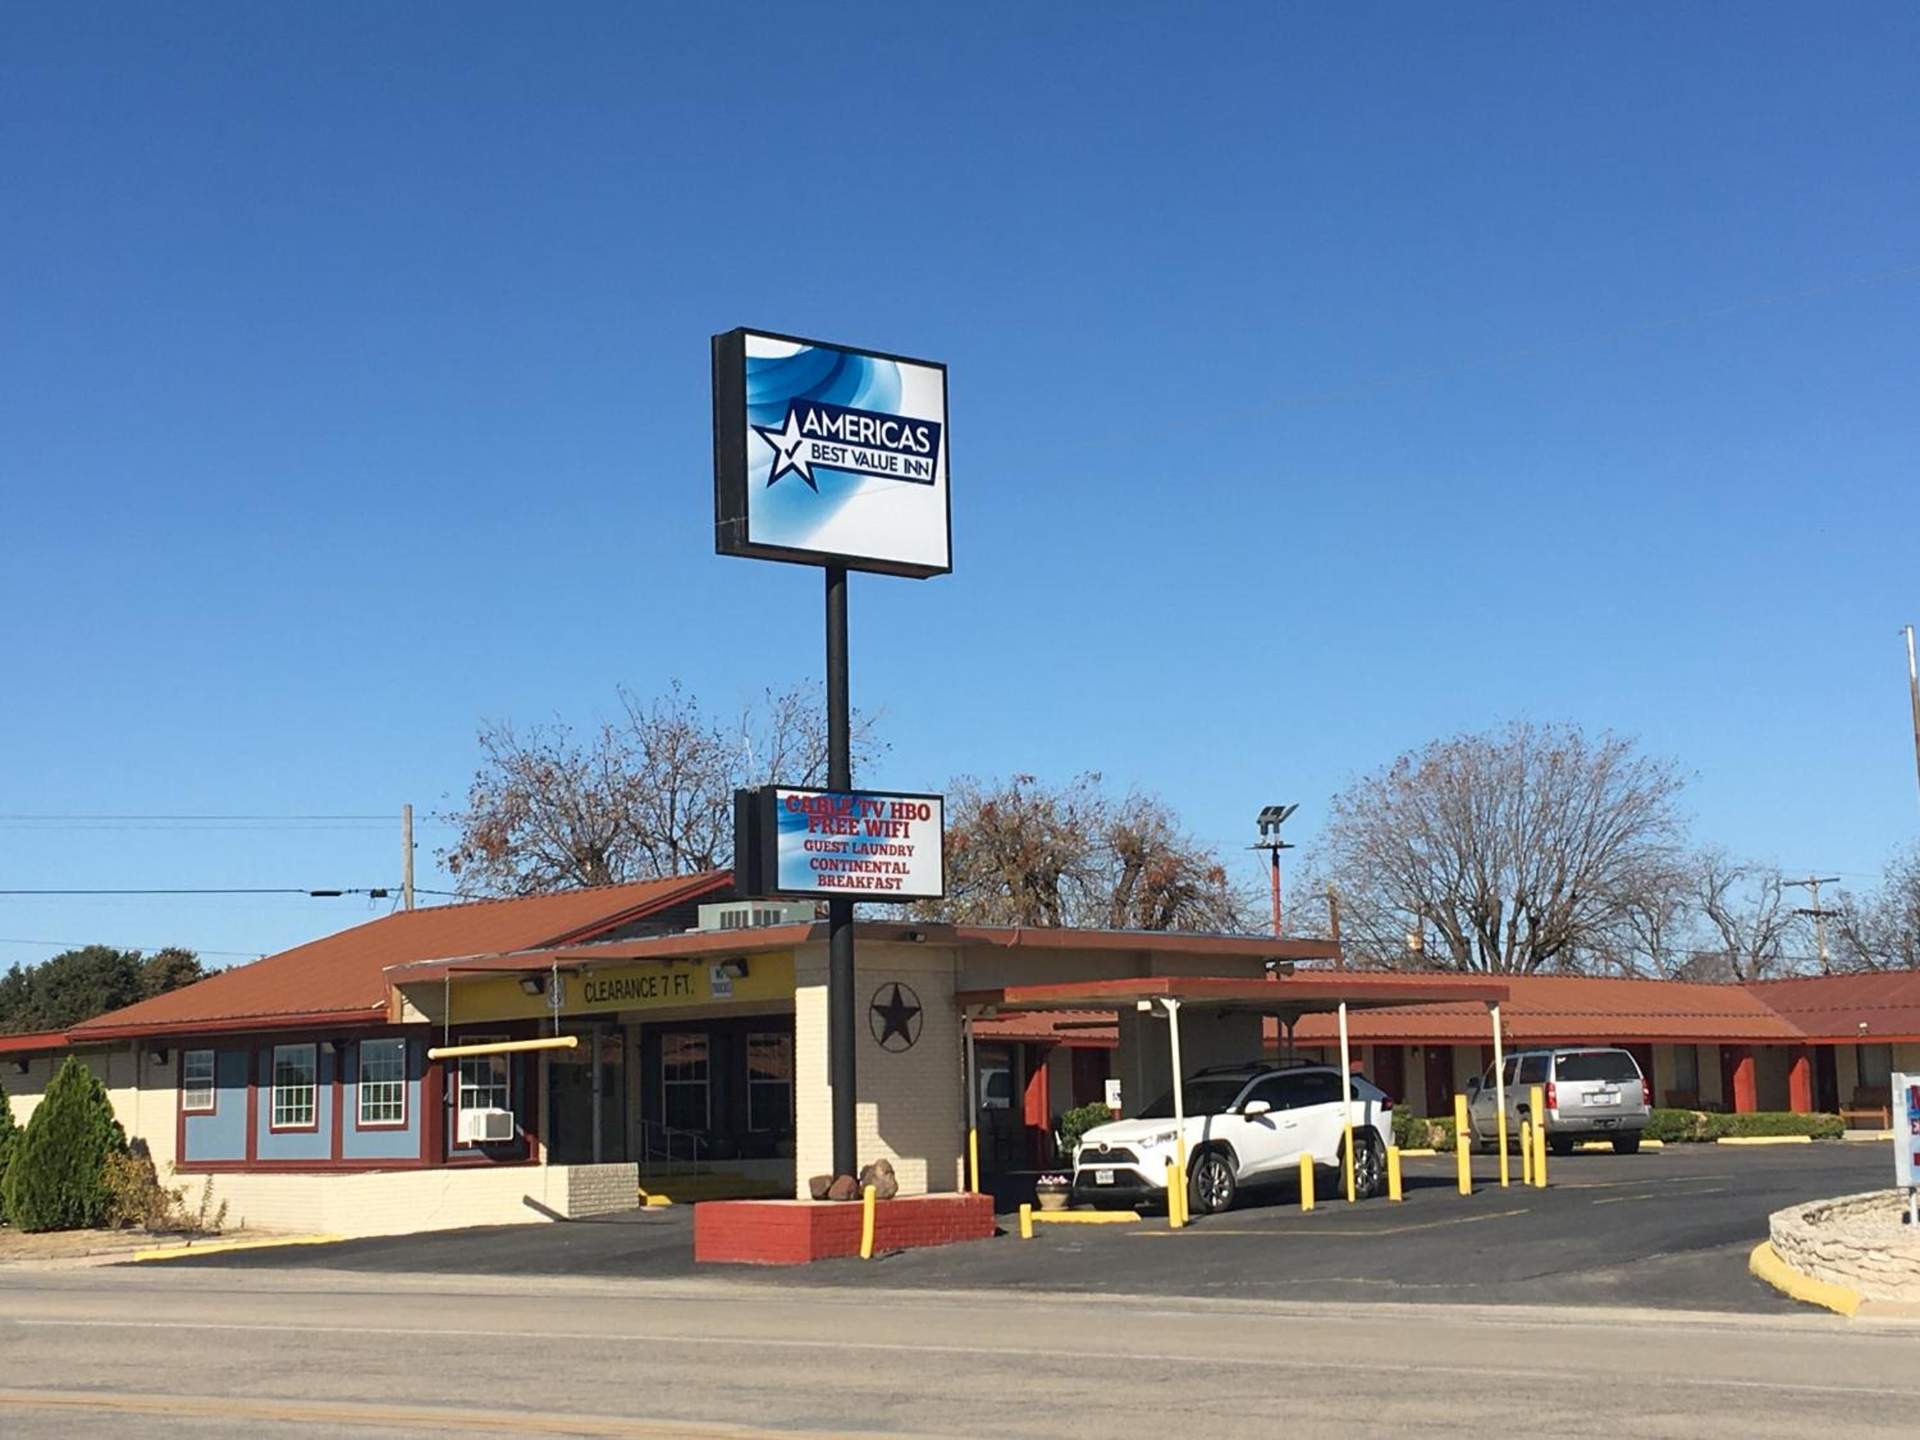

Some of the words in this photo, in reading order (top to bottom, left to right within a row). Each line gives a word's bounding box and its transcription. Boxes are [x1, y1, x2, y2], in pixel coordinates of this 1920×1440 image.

[802, 408, 930, 452] AMERICAS
[811, 443, 848, 464] BEST
[851, 449, 898, 472] VALUE
[904, 460, 929, 476] INN
[858, 799, 886, 818] TV
[890, 802, 931, 821] HBO
[808, 815, 859, 836] FREE
[864, 819, 910, 839] WIFI
[804, 839, 849, 856] GUEST
[852, 842, 915, 857] LAUNDRY
[809, 857, 910, 875] CONTINENTAL
[817, 875, 903, 890] BREAKFAST
[584, 976, 656, 1003] CLEARANCE
[660, 976, 669, 997] 7
[674, 974, 695, 995] FT.
